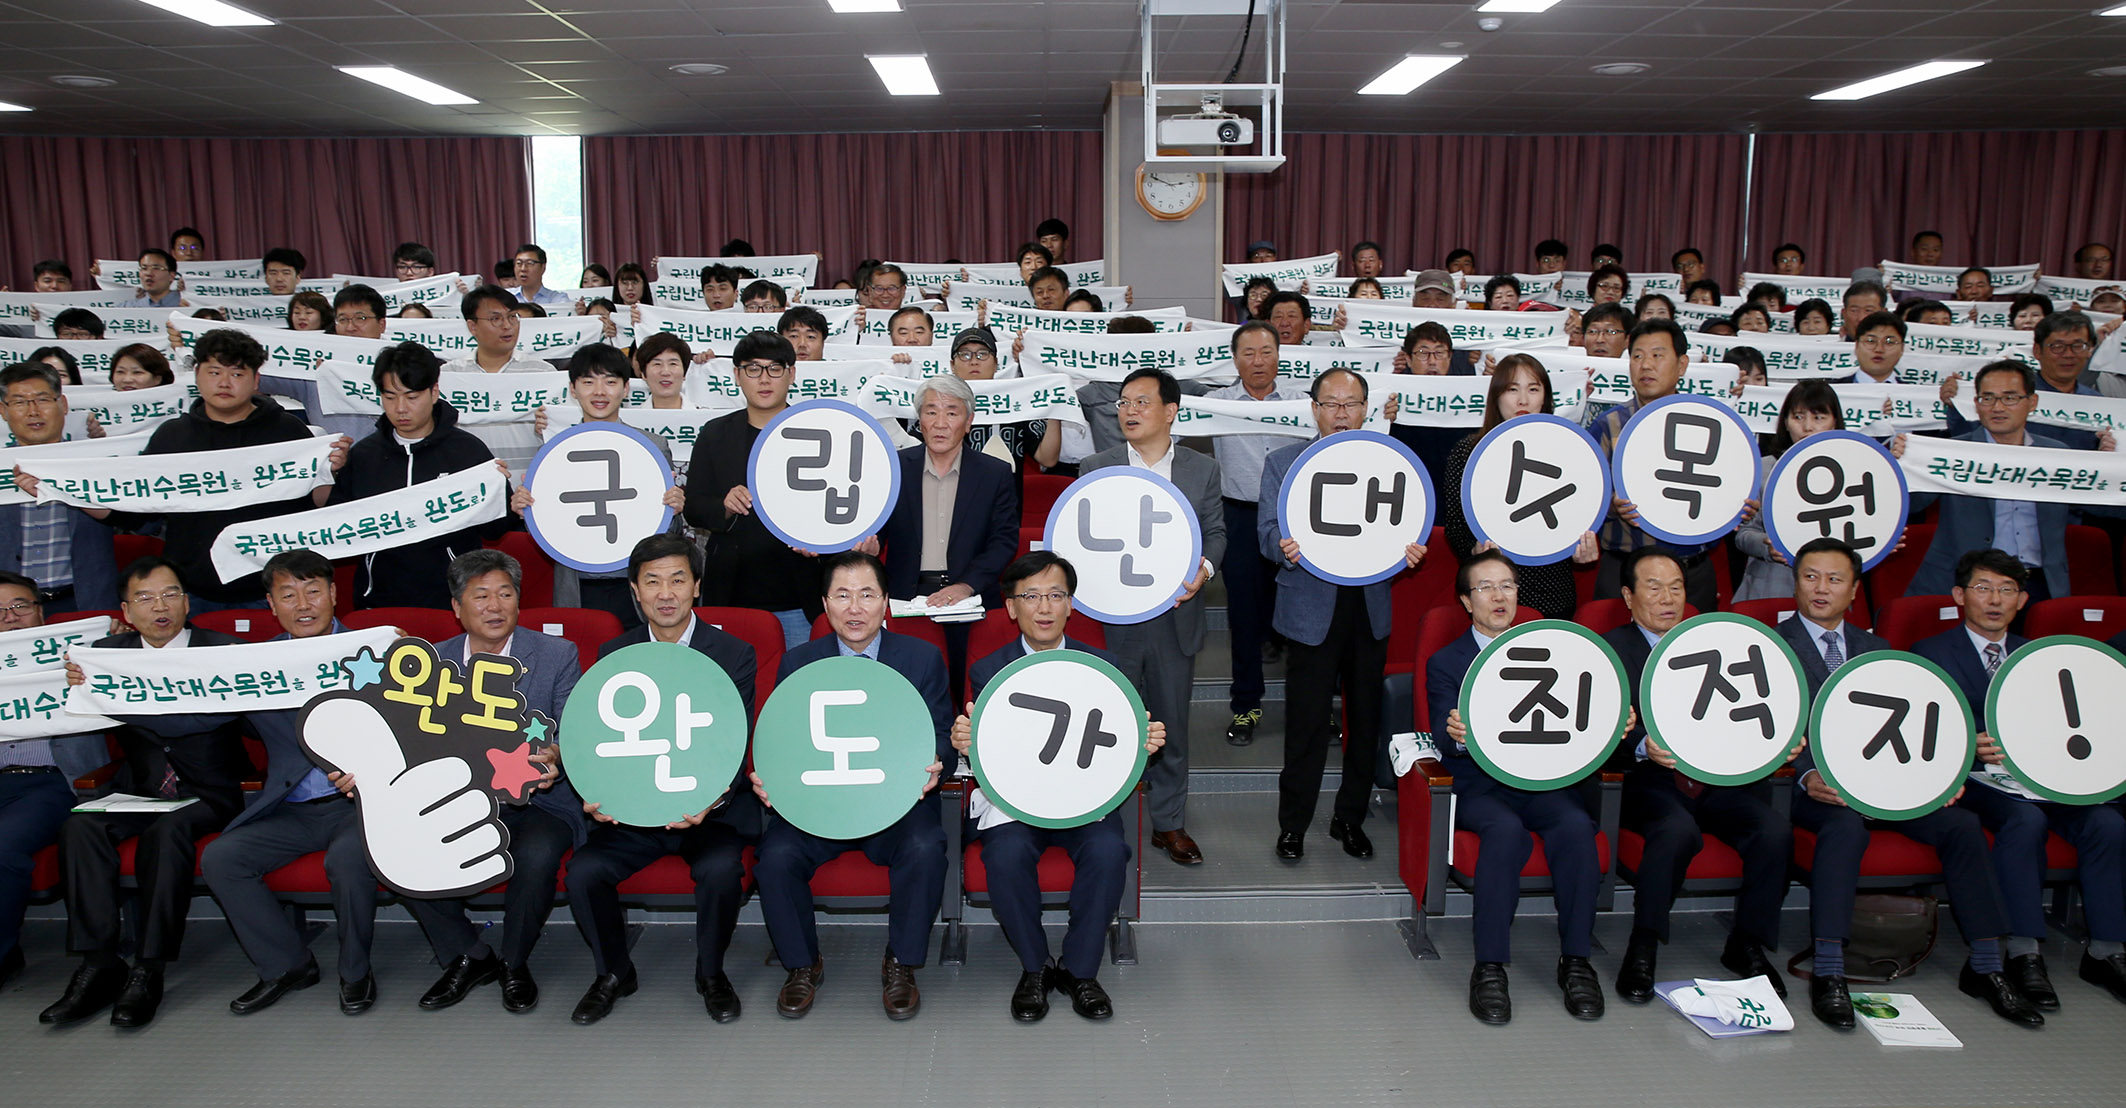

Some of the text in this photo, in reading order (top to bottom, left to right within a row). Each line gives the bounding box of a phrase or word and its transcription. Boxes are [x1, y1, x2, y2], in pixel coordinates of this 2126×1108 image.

[532, 331, 581, 352] 완도로!
[1040, 346, 1186, 370] 국립난대수목원을
[252, 457, 318, 489] 완도로!
[559, 449, 638, 544] 국
[781, 427, 864, 524] 립
[1310, 471, 1406, 537] 대
[1504, 440, 1577, 530] 수
[1654, 411, 1722, 520] 목
[1797, 455, 1876, 550] 원
[1927, 457, 2108, 491] 국립난대수목원을
[234, 482, 487, 556] 국립난대수목원을 완도로!
[1078, 494, 1173, 587] 난
[90, 669, 306, 703] 국립난대수목원을
[383, 645, 519, 734] 완도
[1008, 692, 1118, 769] 가
[1498, 646, 1593, 745] 최
[1668, 644, 1775, 740] 적
[1848, 690, 1940, 764] 지
[2058, 668, 2092, 760] !
[595, 671, 714, 792] 완
[800, 689, 886, 786] 도
